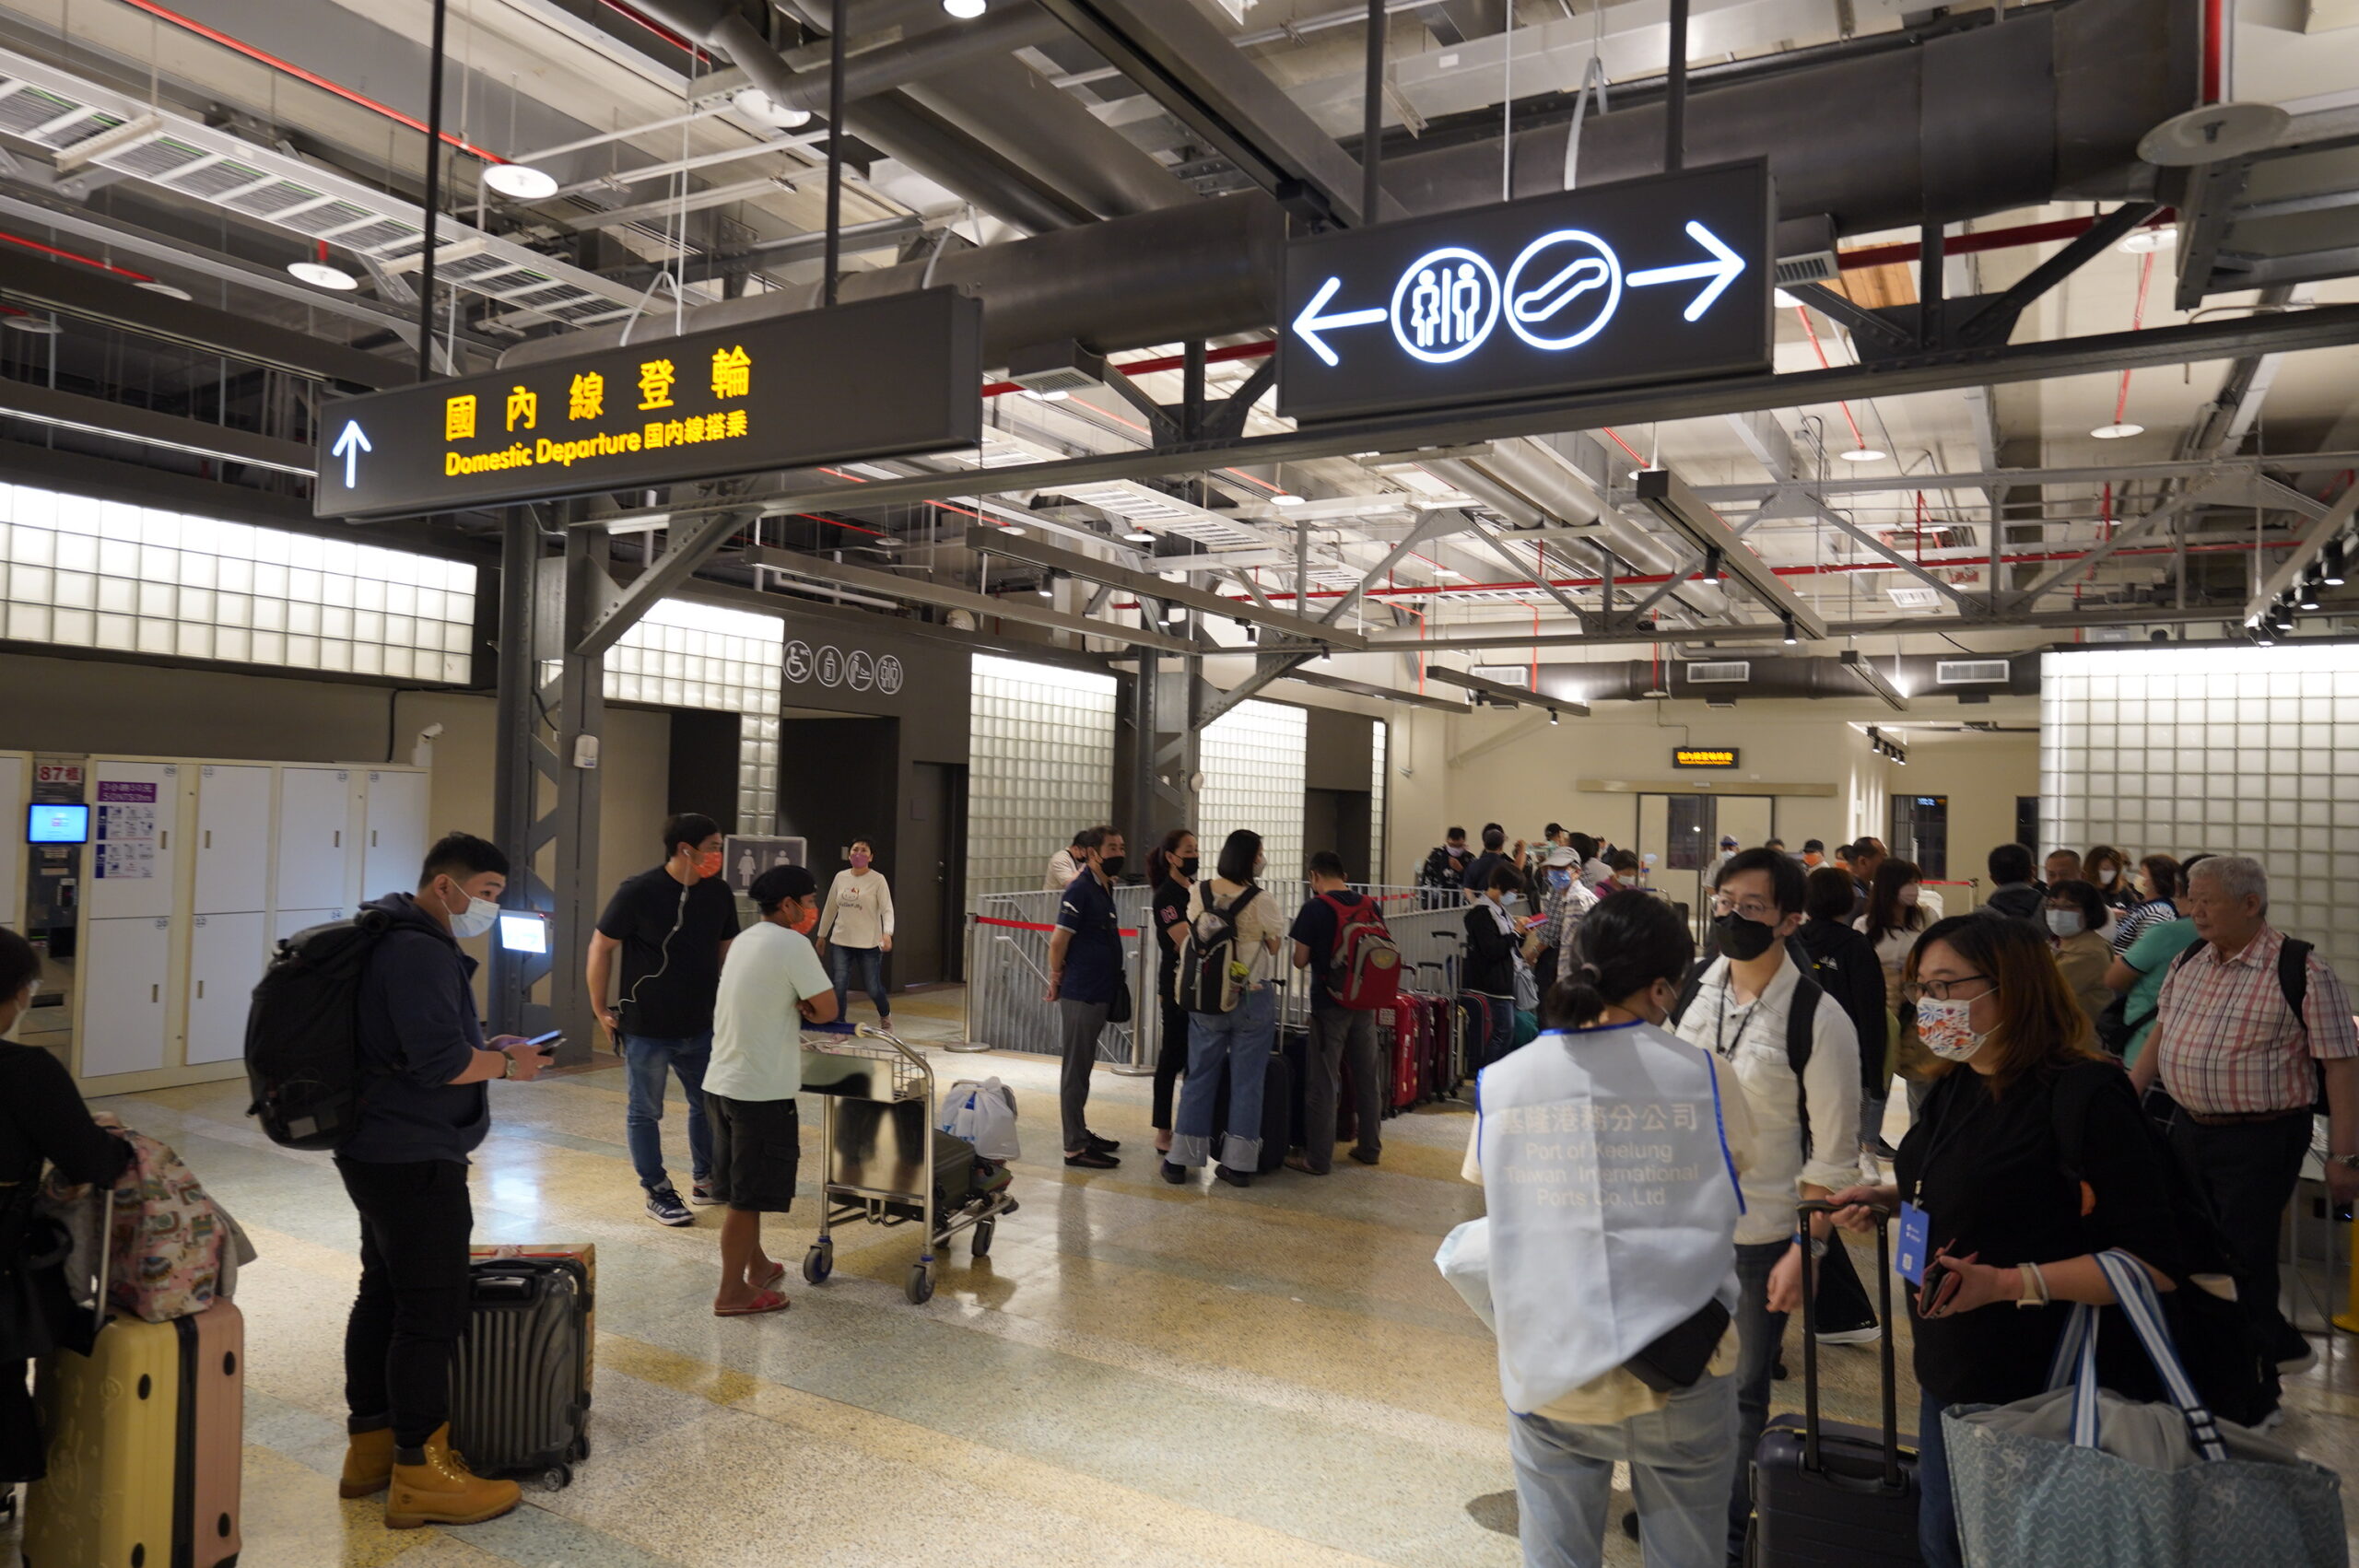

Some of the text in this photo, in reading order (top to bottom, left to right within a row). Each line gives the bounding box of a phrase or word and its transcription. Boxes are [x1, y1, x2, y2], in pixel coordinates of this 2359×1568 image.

[446, 345, 751, 441] 國內線登輪
[446, 432, 641, 476] Domestic Departure
[1159, 905, 1179, 924] 03
[1526, 1141, 1672, 1163] Port of Keelung
[1505, 1164, 1699, 1184] Taiwan International
[1537, 1188, 1586, 1206] Ports
